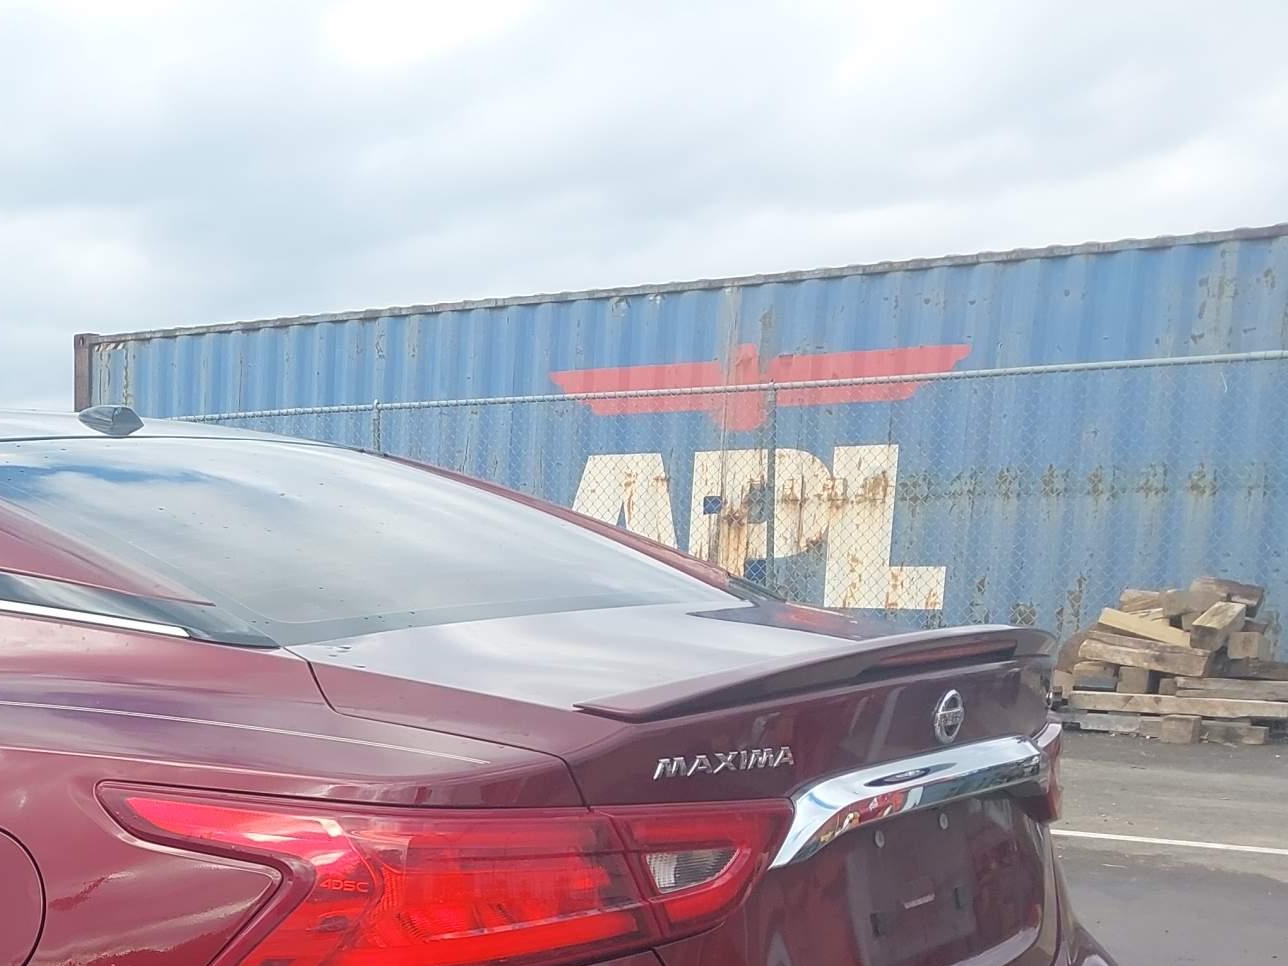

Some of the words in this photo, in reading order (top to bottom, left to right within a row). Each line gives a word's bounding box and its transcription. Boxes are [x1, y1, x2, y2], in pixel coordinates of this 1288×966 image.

[570, 443, 948, 610] APL
[653, 745, 795, 780] MAXIMA
[319, 878, 369, 893] 4DSC
